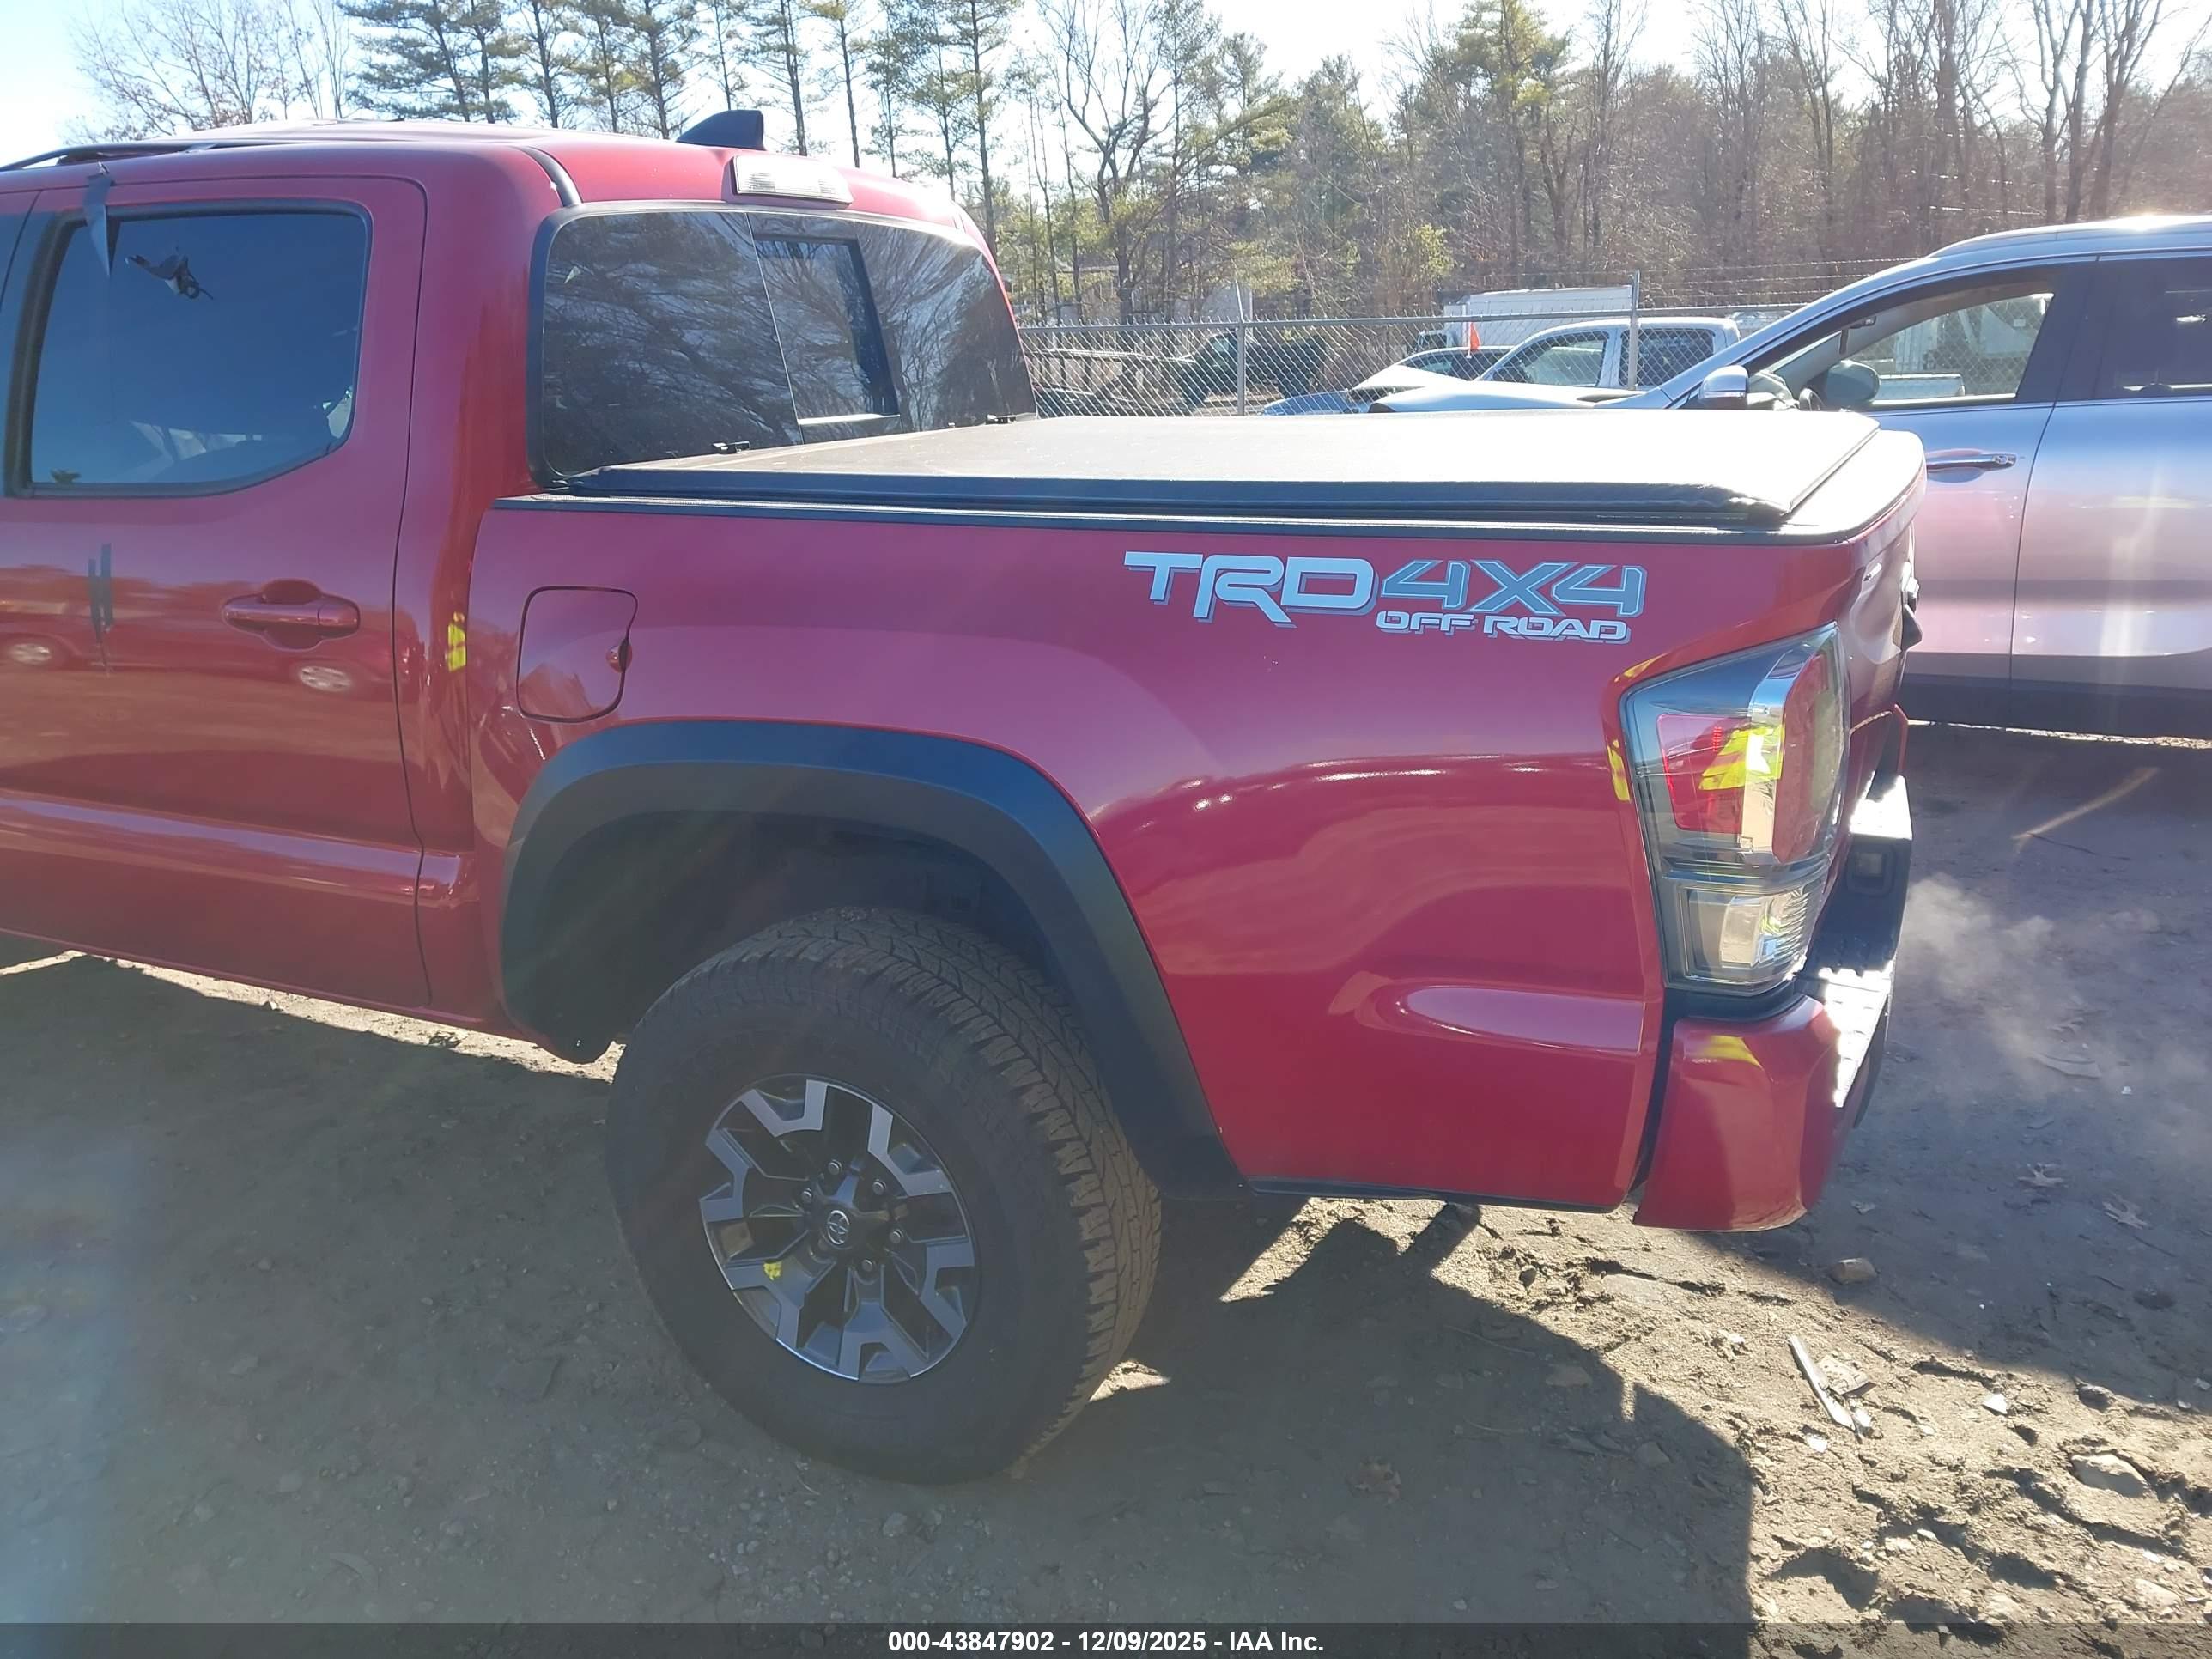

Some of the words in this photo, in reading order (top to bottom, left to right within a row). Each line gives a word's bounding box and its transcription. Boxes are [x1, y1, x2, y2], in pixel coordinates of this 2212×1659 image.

[1124, 550, 1376, 628] TRD
[1381, 558, 1647, 617] 4X4
[1376, 611, 1476, 634] OFF
[1483, 614, 1631, 644] ROAD
